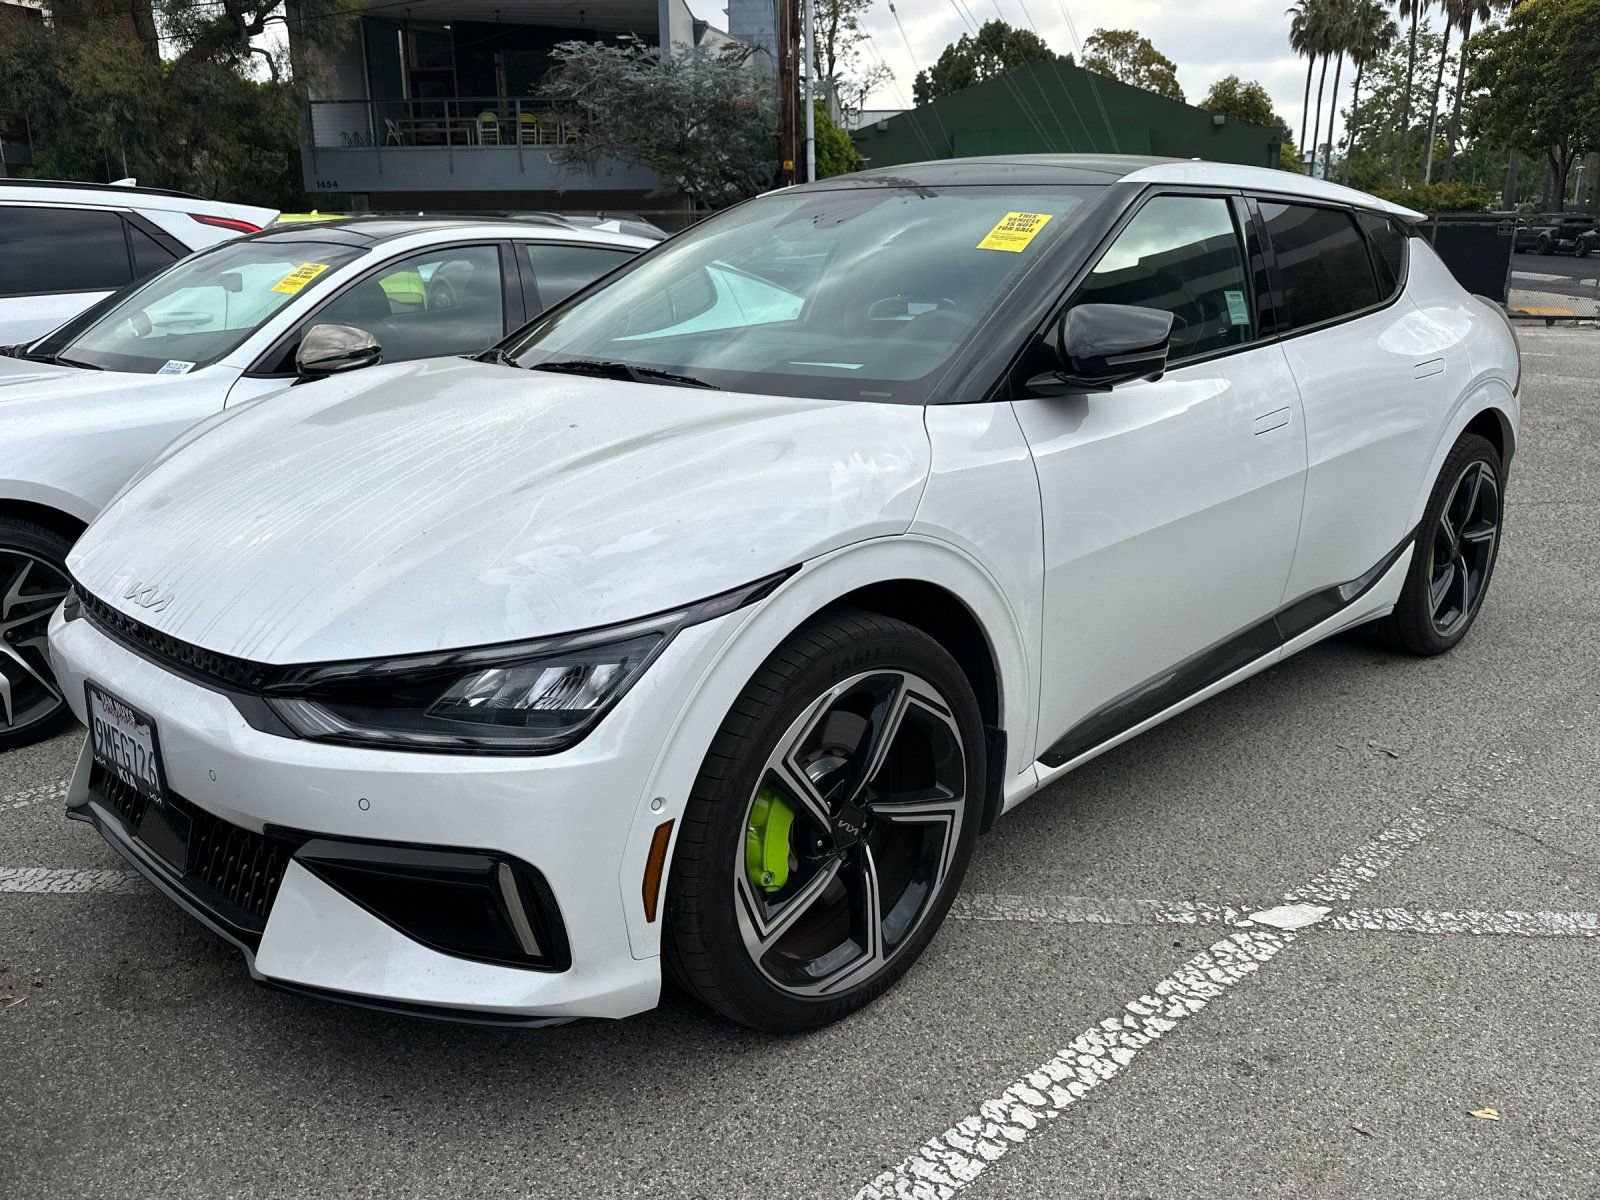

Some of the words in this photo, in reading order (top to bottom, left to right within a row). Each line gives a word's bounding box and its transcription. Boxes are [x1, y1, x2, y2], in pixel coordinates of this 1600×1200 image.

[316, 180, 338, 188] 1454
[95, 717, 158, 787] 9MFG726
[117, 765, 138, 791] KIA
